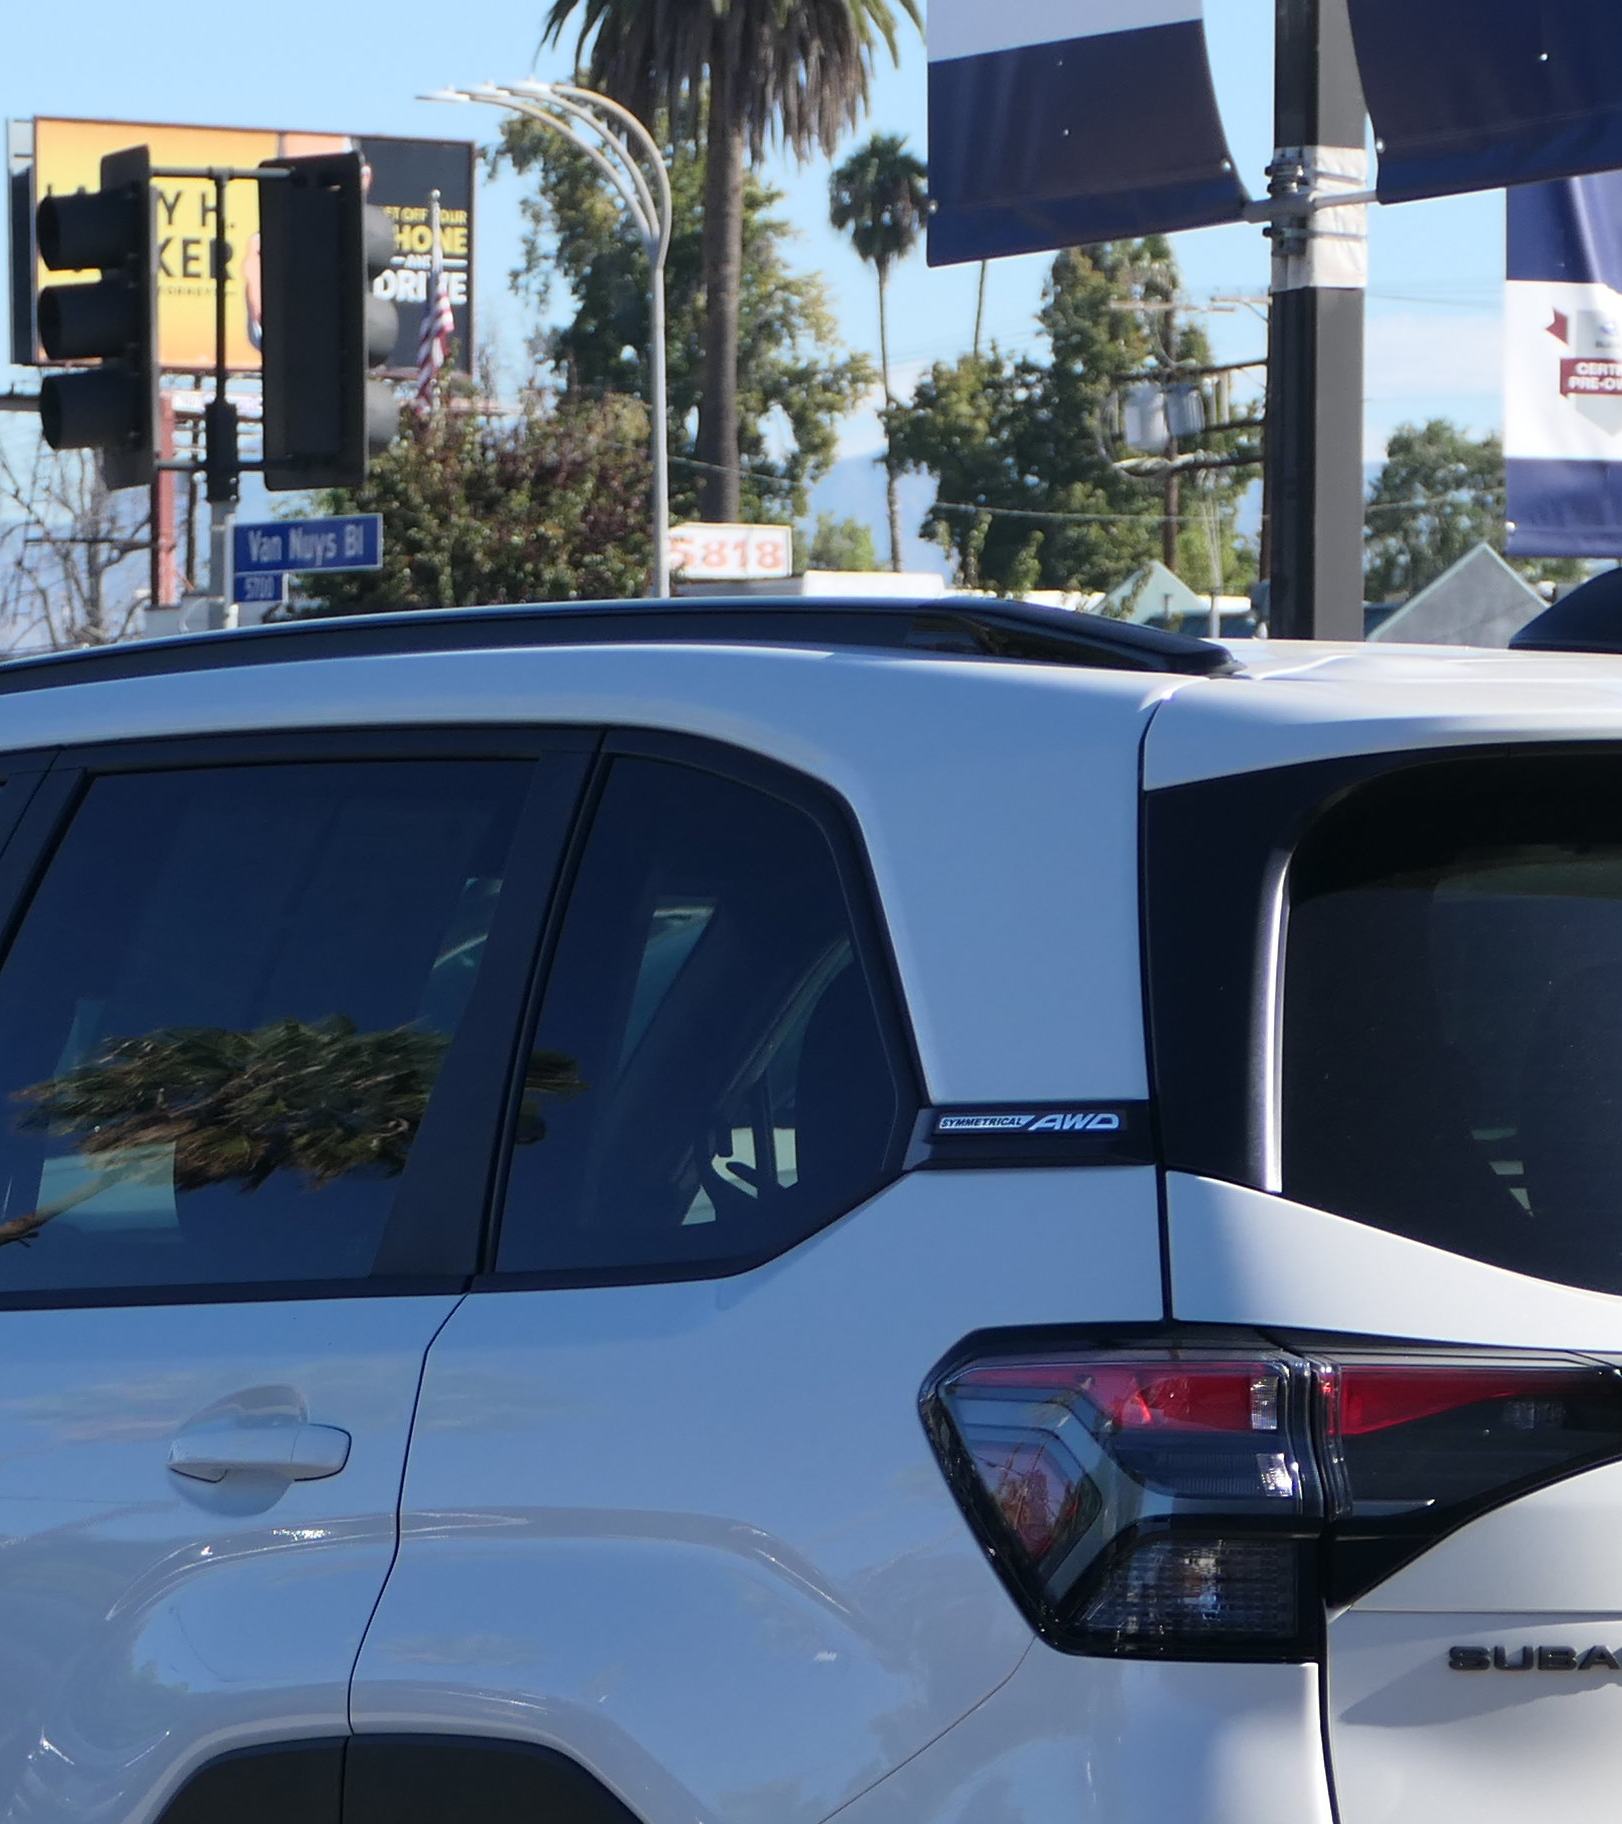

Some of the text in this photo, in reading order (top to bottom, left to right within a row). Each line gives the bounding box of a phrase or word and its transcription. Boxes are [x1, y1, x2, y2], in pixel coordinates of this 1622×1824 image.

[440, 208, 468, 225] OUR
[393, 223, 468, 255] HONE
[247, 523, 365, 566] Van Nuys Bl
[670, 536, 784, 569] 5818
[940, 1112, 1120, 1131] SYMMETRICAL AWD
